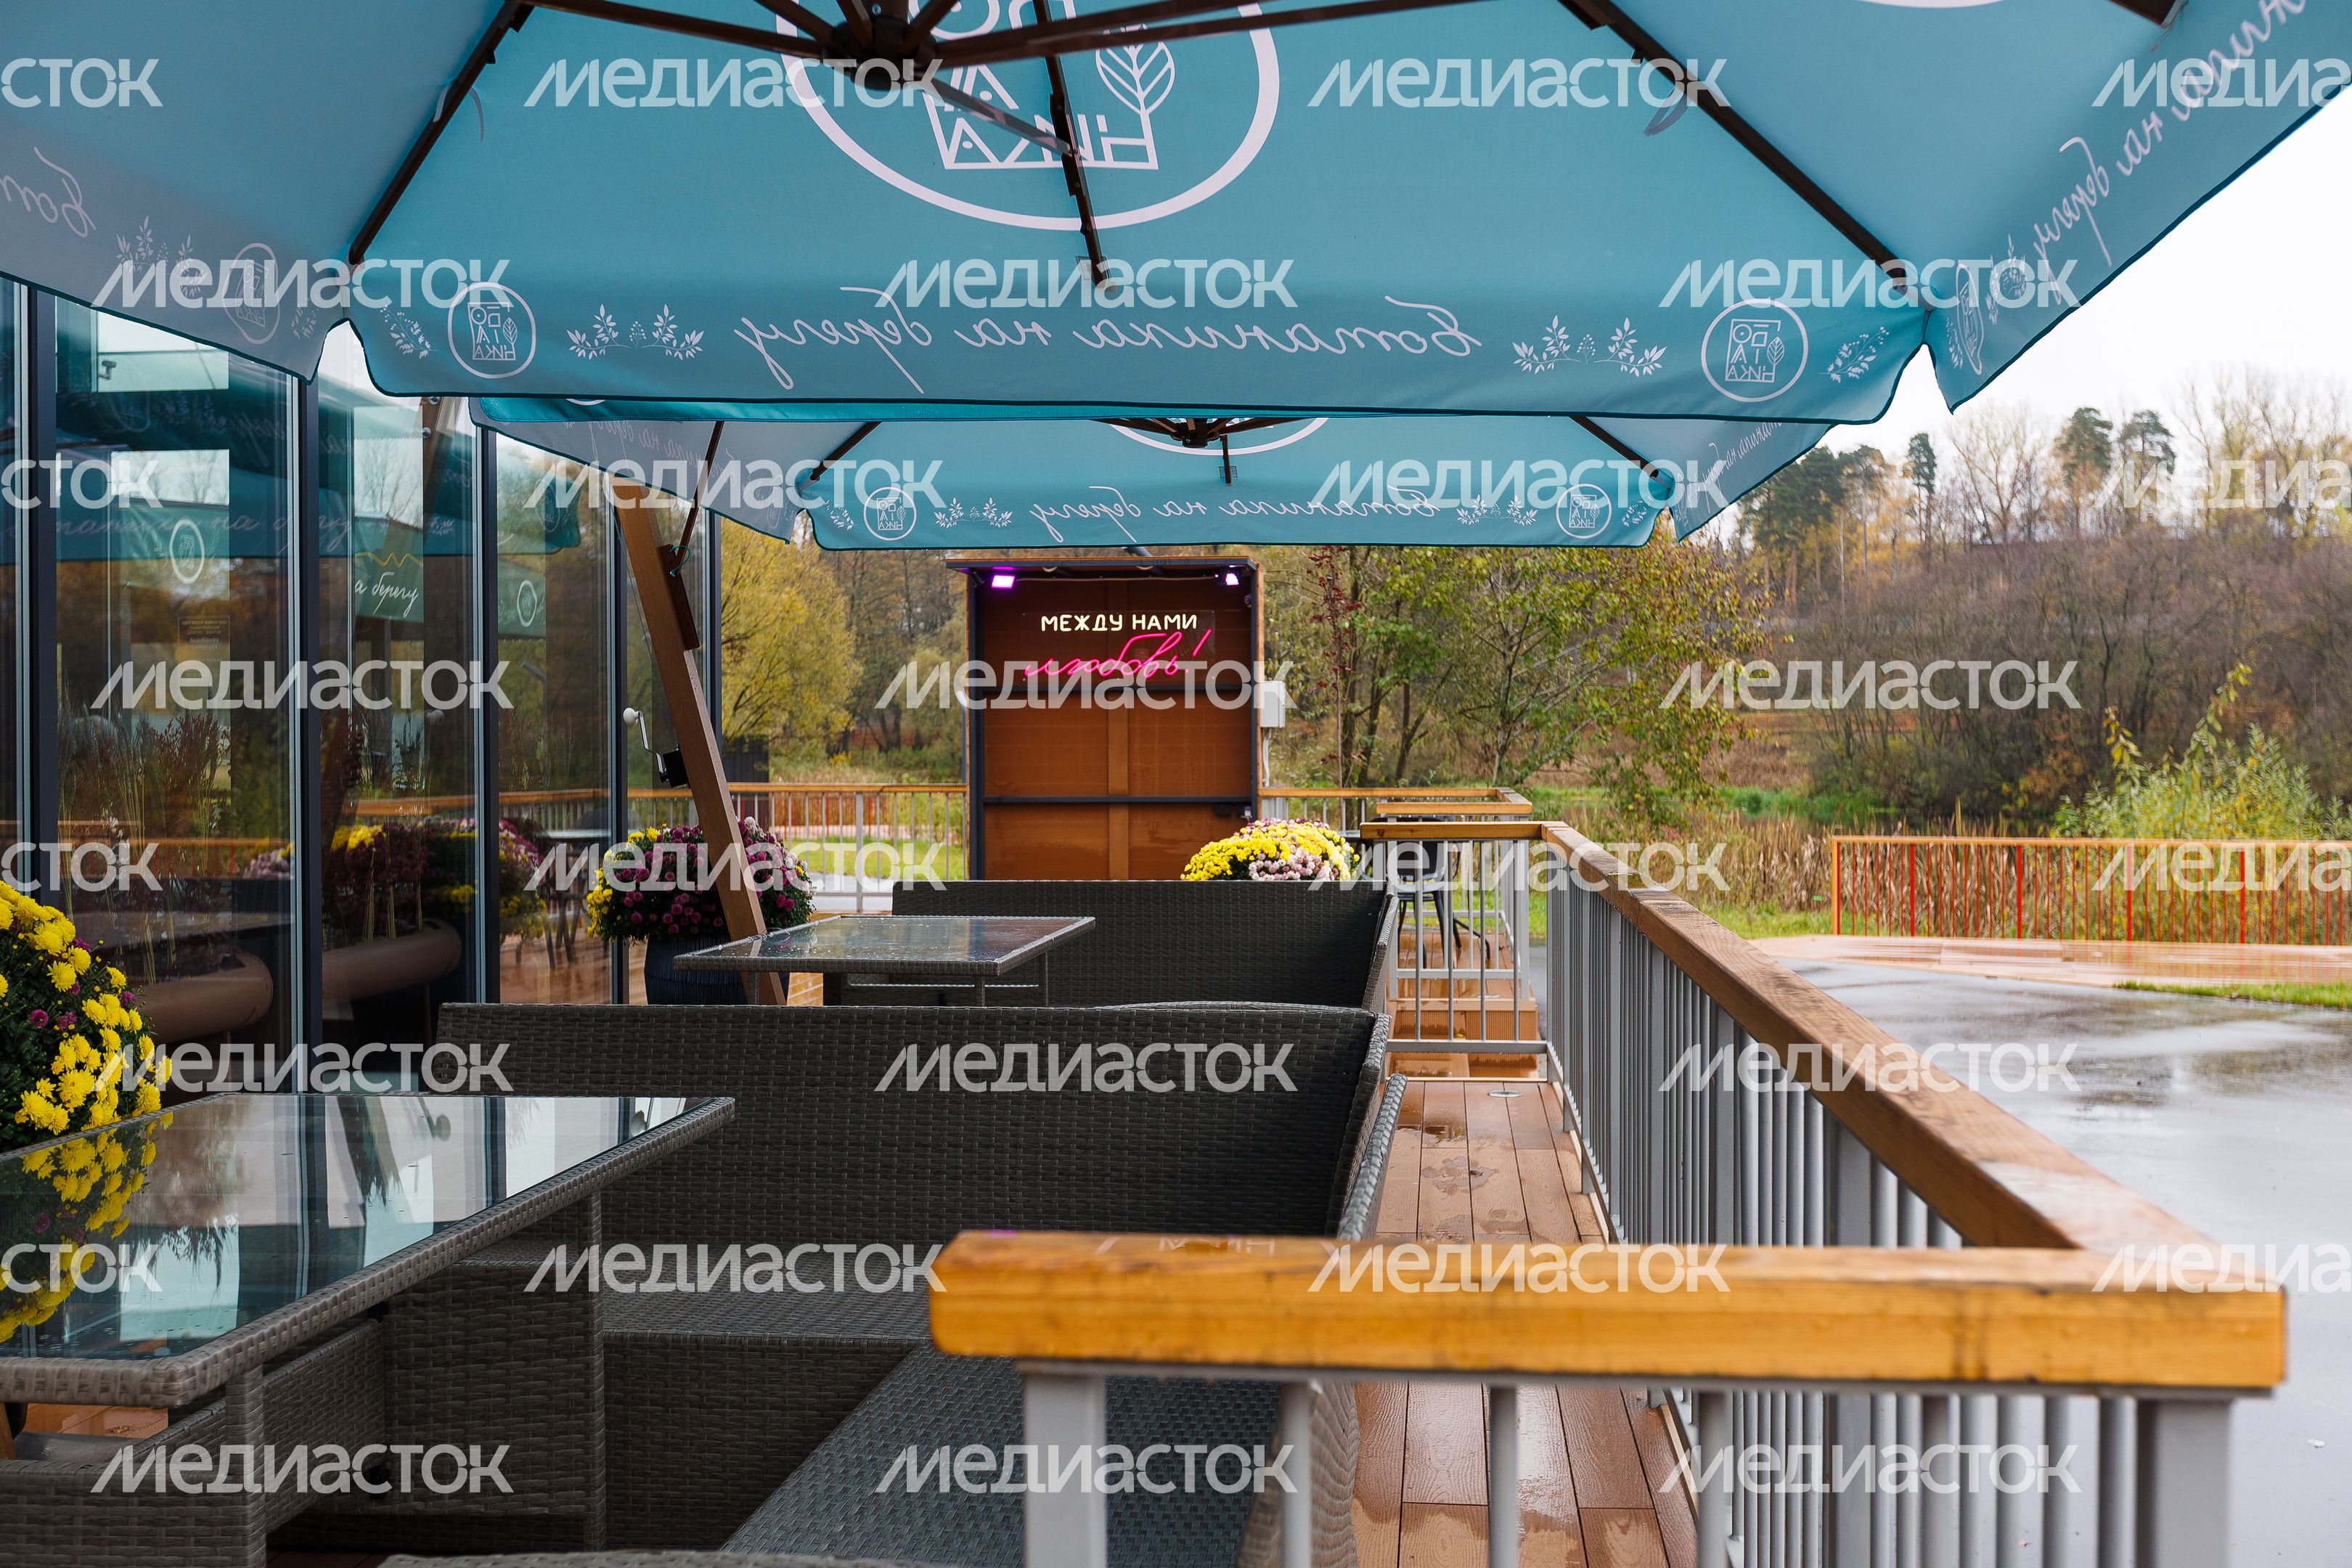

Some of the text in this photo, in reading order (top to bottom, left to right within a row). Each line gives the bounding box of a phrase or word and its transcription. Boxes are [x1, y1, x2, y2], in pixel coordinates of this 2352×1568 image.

[354, 571, 420, 619] а берегу
[1041, 613, 1199, 632] МЕЖДУ НАМИ
[1024, 628, 1212, 679] любовь!
